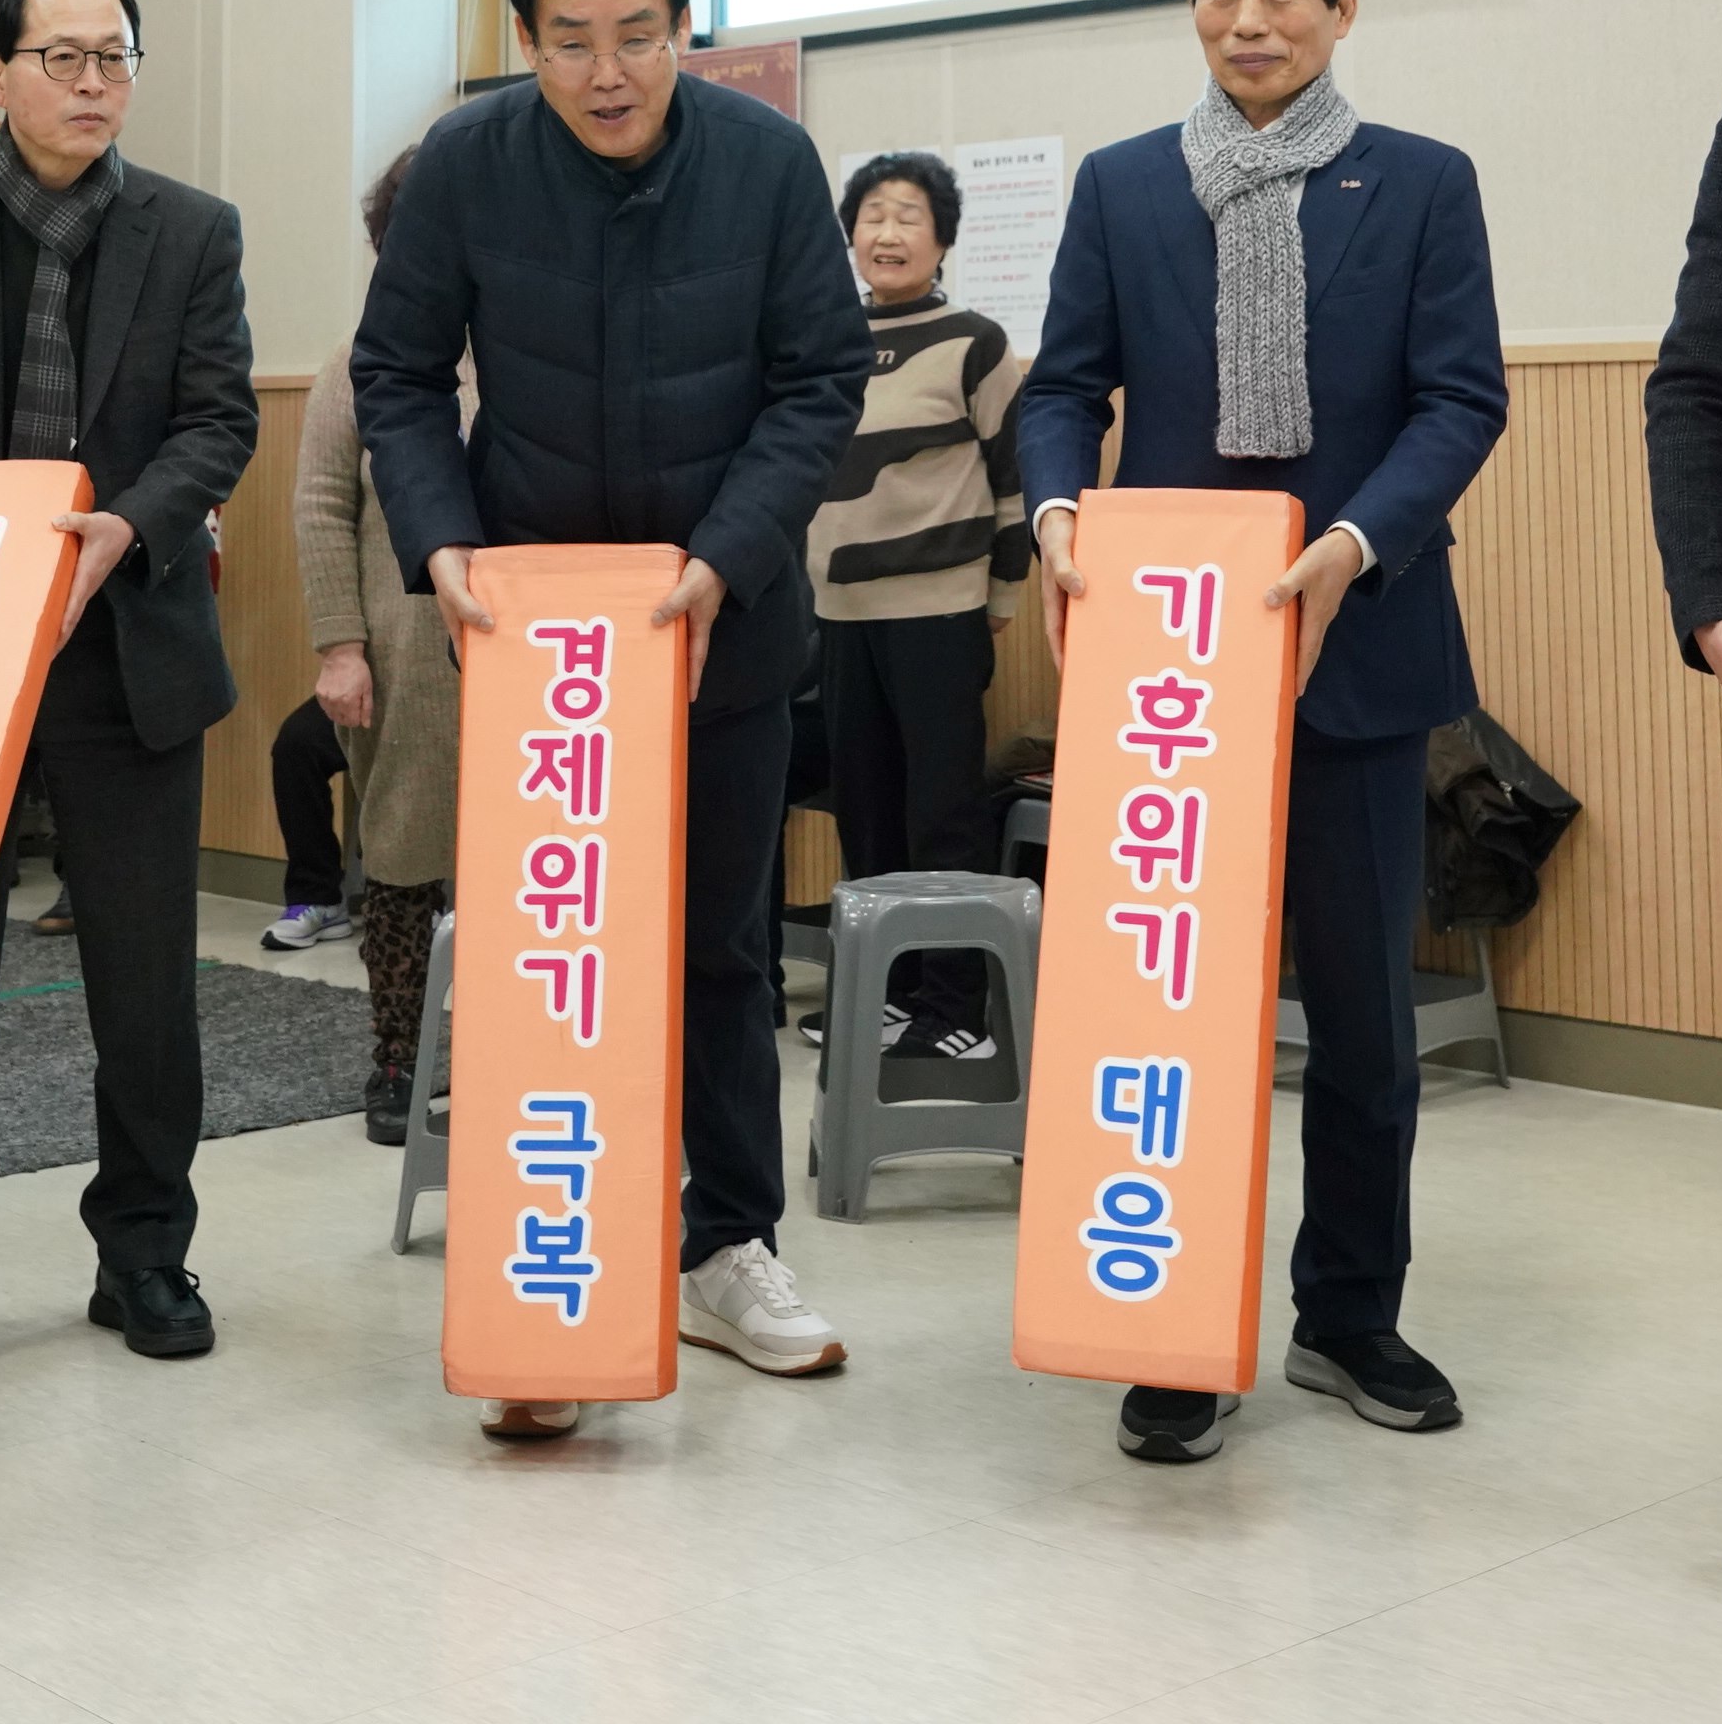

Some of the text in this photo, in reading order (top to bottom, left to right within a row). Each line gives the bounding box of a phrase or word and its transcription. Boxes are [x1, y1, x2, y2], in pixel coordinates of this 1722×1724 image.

[514, 626, 606, 1317] 경제위기 극복
[1089, 574, 1216, 1292] 기후위기 대응
